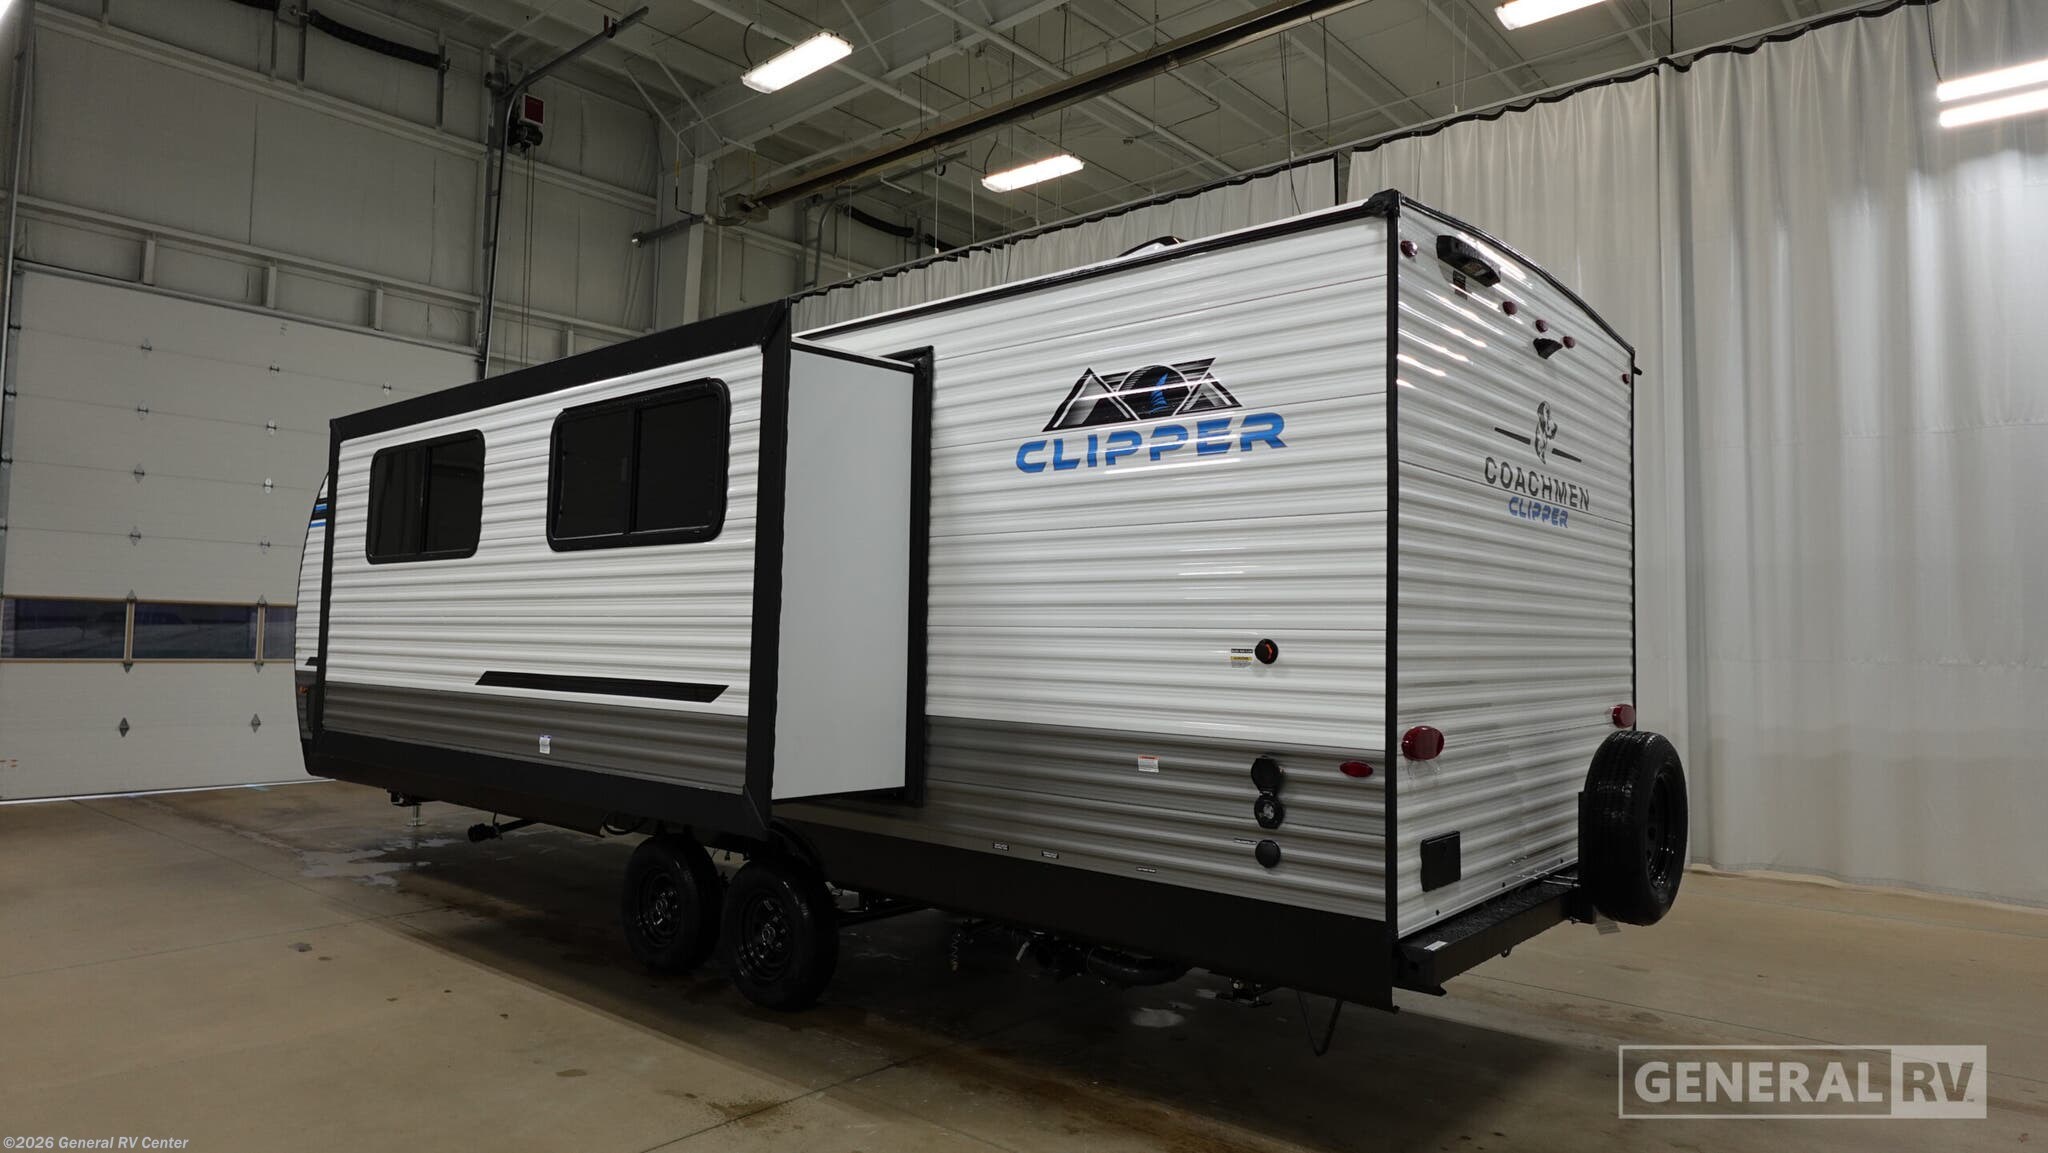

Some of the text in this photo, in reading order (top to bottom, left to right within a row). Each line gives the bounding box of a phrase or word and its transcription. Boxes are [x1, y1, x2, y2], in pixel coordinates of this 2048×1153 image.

[1015, 412, 1288, 474] CLIPPER
[1484, 456, 1590, 511] COACHMEN
[1508, 496, 1569, 528] CLIPPER
